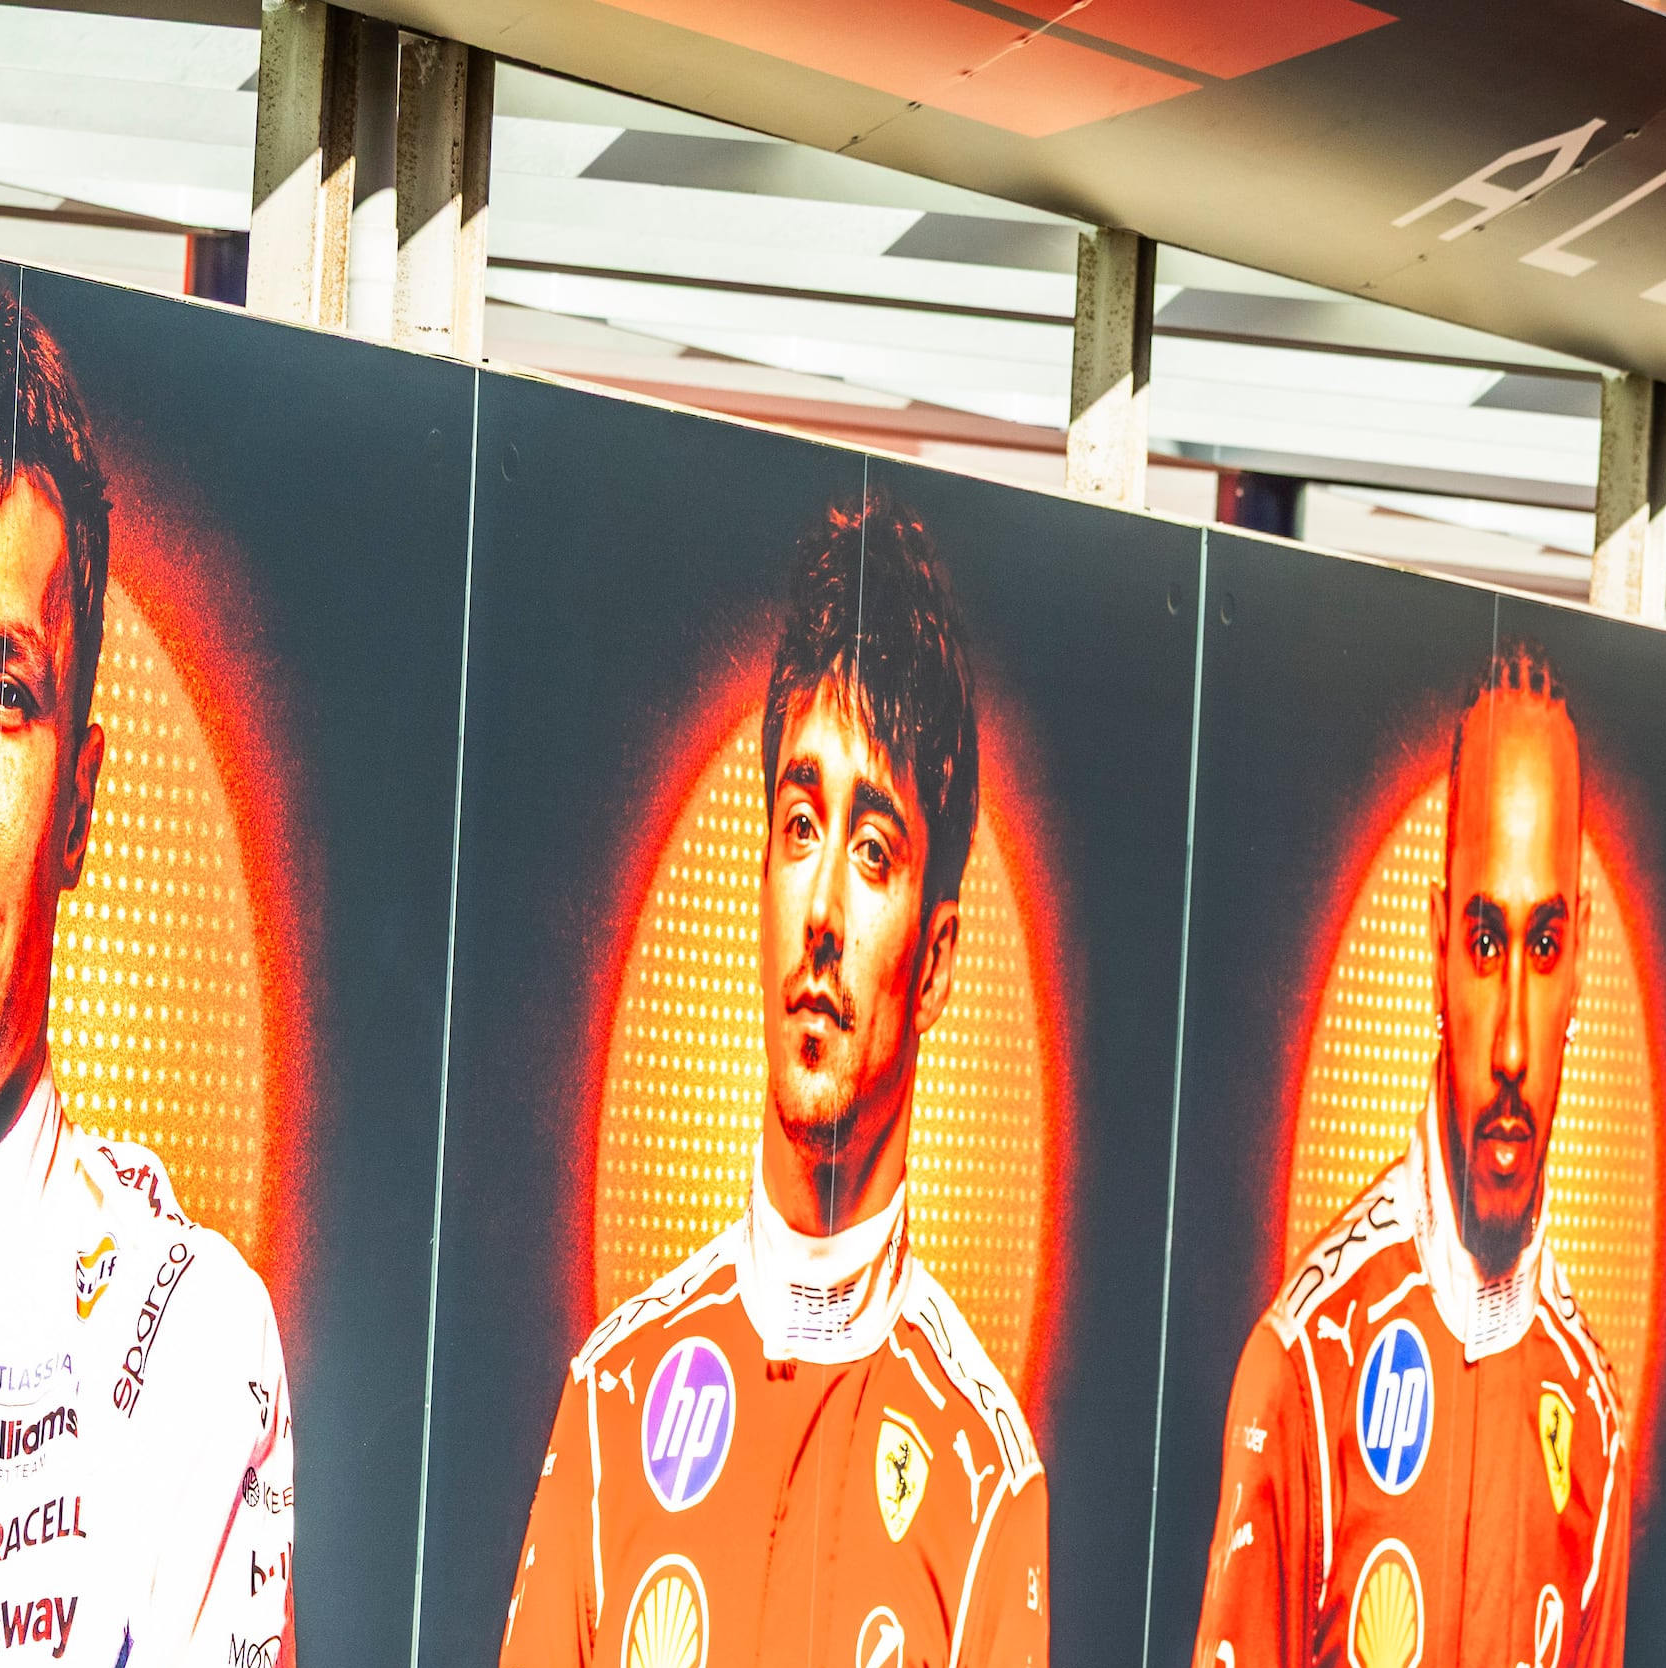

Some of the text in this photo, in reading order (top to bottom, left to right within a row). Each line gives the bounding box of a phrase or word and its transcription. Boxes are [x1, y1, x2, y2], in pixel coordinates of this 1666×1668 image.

[112, 1242, 191, 1413] sparco
[1363, 1326, 1429, 1488] hp
[649, 1343, 730, 1502] hp
